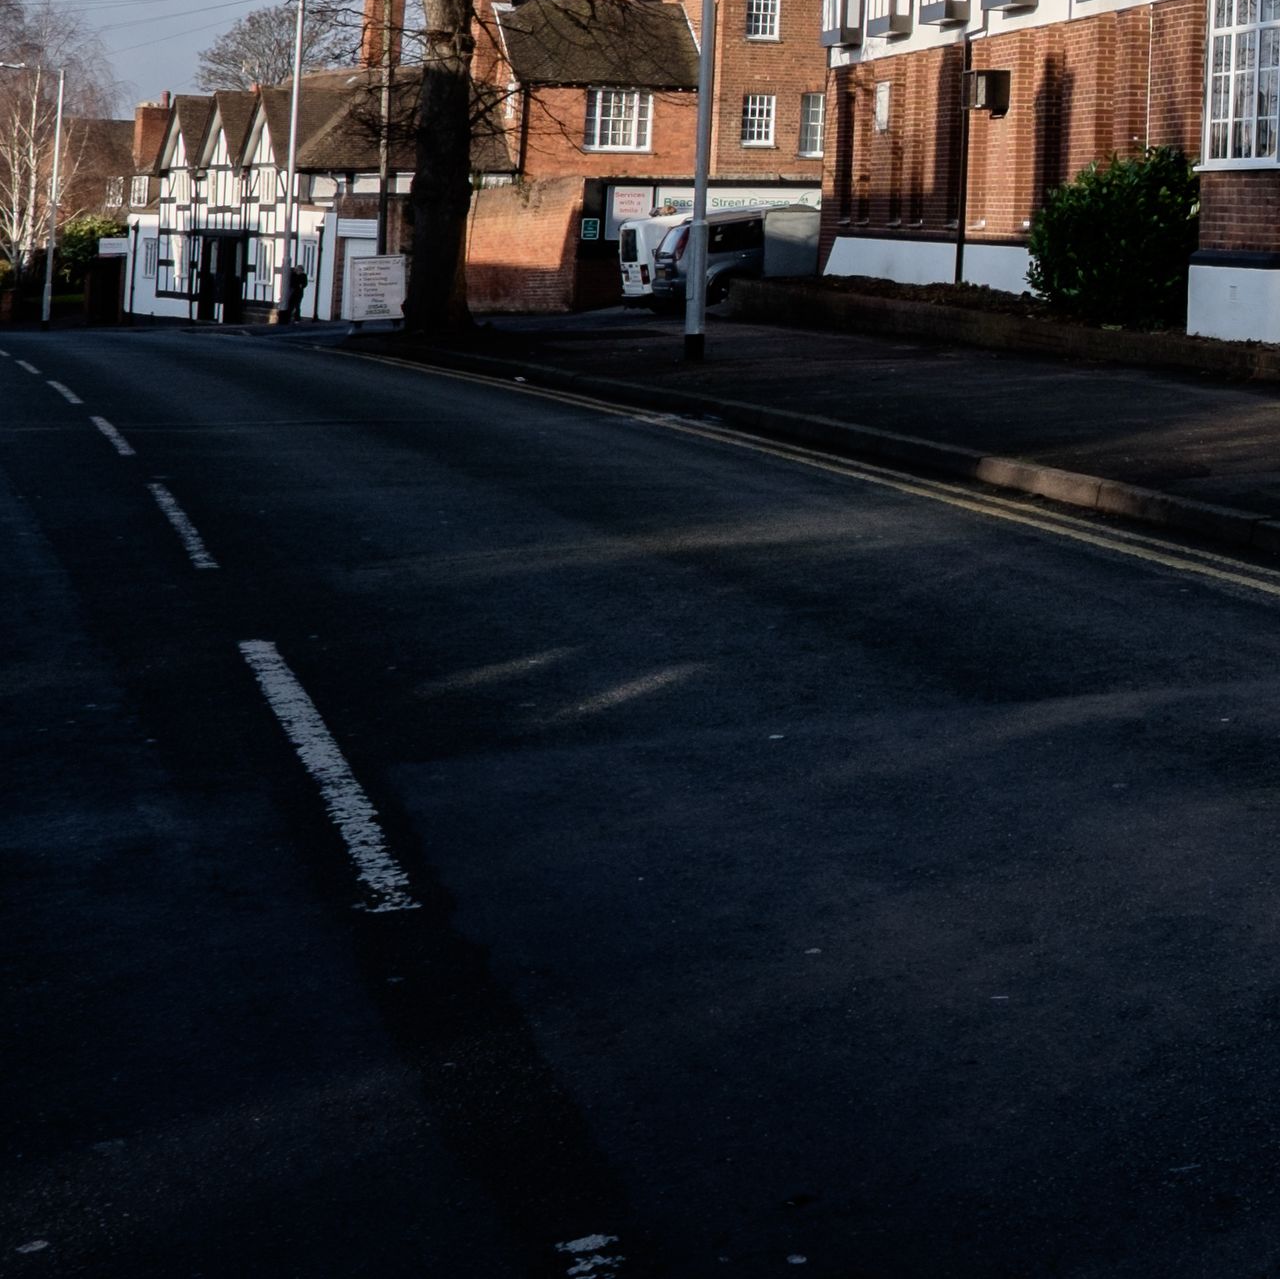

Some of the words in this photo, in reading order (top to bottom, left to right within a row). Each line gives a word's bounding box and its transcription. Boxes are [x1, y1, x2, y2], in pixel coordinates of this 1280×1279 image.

[664, 197, 693, 208] Beac
[711, 197, 745, 208] Street
[748, 198, 790, 207] Garage
